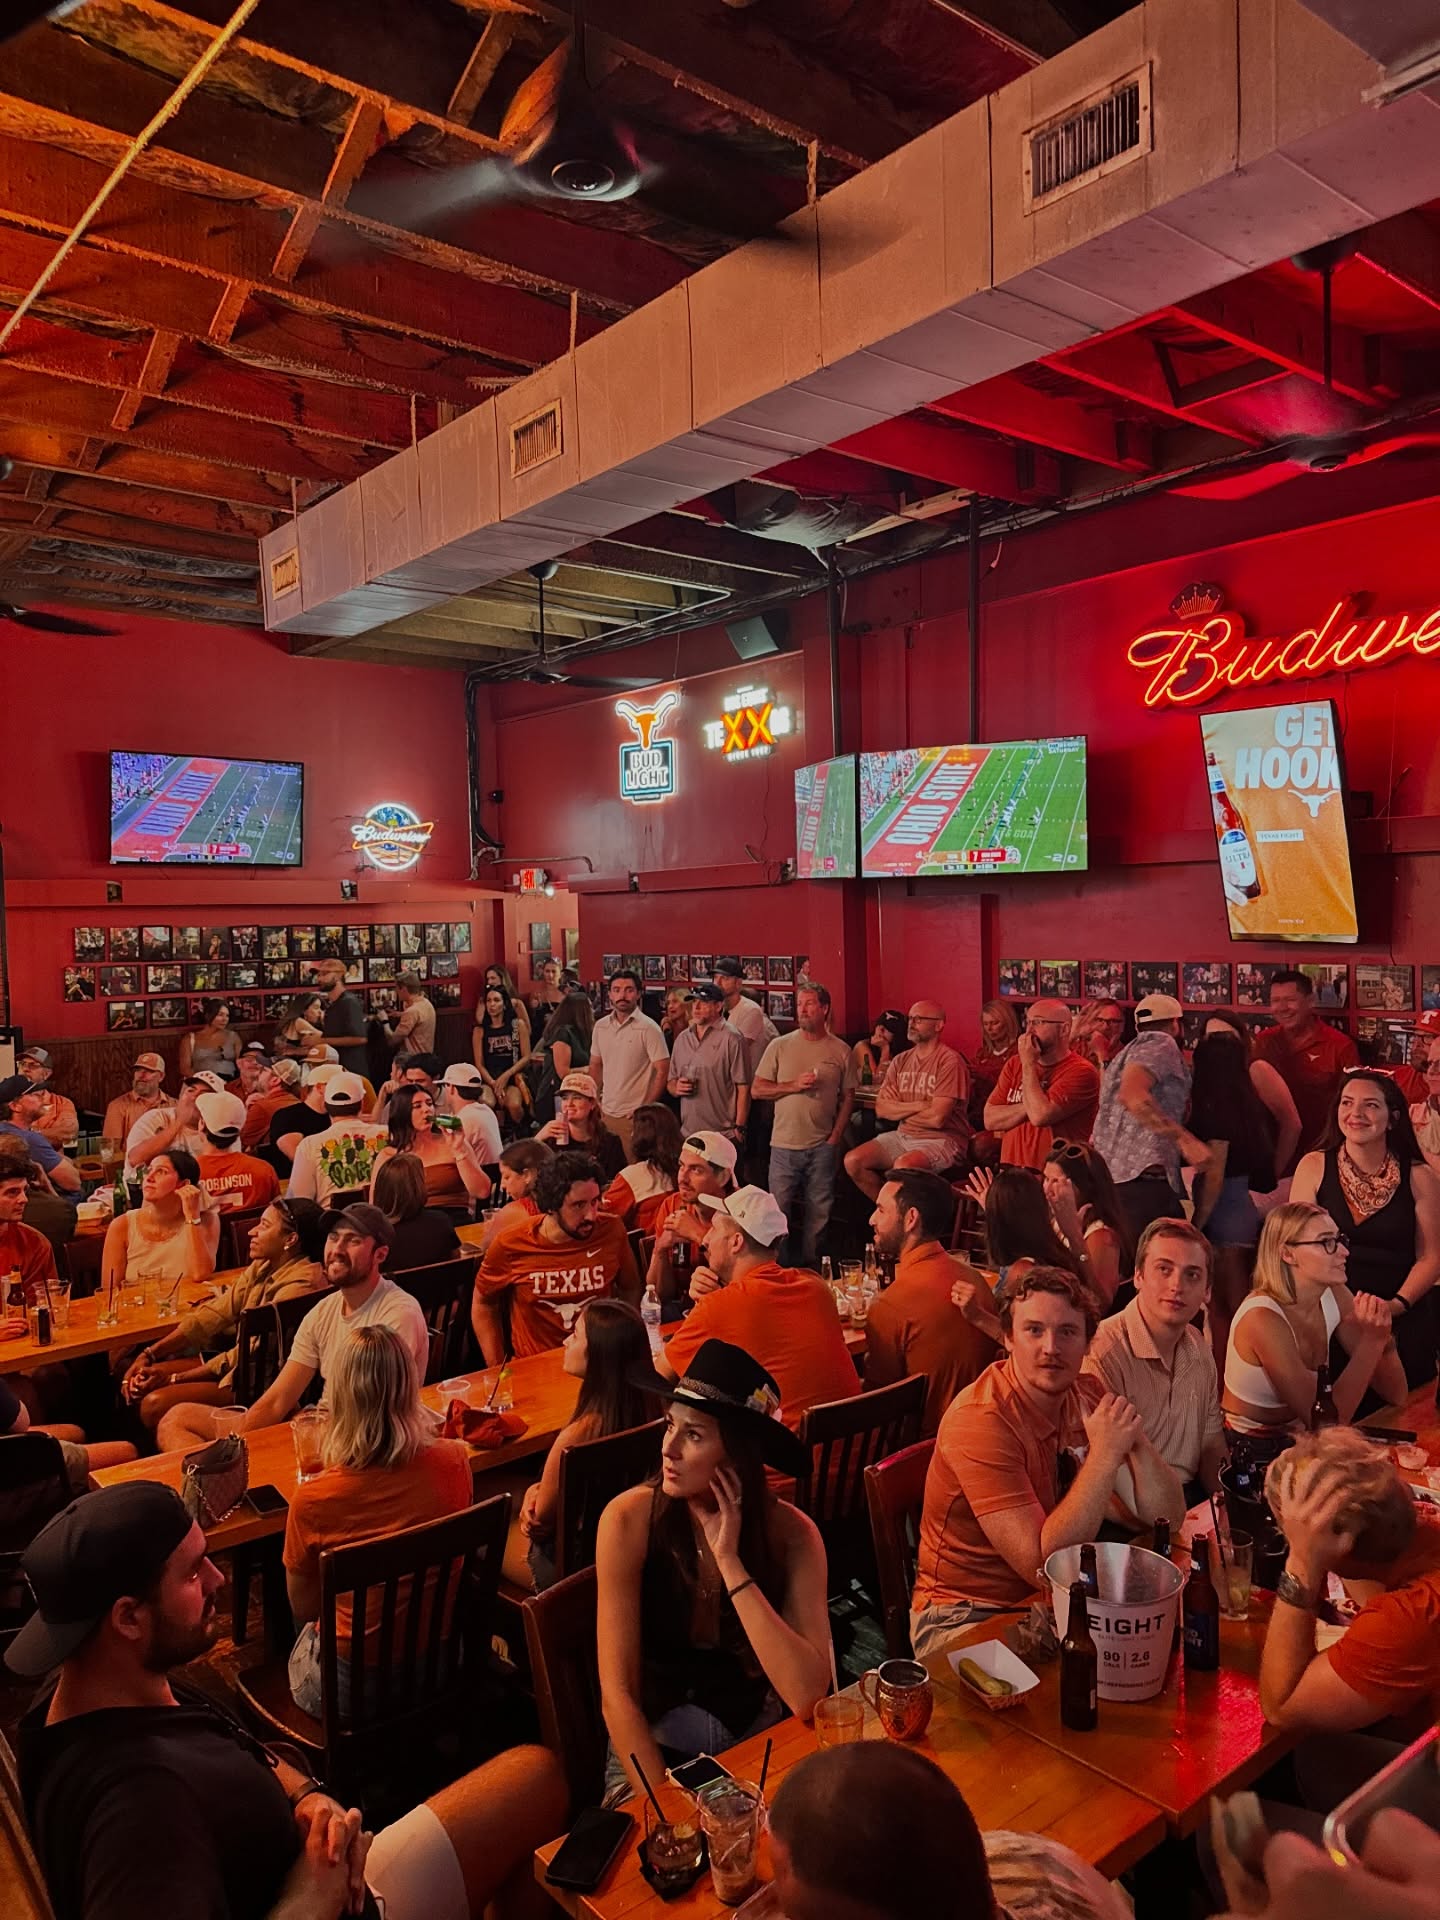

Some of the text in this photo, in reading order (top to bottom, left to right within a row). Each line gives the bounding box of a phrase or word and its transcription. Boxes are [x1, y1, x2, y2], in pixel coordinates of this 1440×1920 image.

[630, 749, 662, 769] BUD
[625, 767, 669, 789] LIGHT
[885, 804, 949, 845] OHIO
[918, 762, 978, 801] STATE
[134, 801, 194, 837] OHIO
[351, 825, 431, 843] Budweiser
[802, 816, 819, 852] OHIO
[1421, 1010, 1439, 1024] T
[529, 1265, 605, 1294] TEXAS
